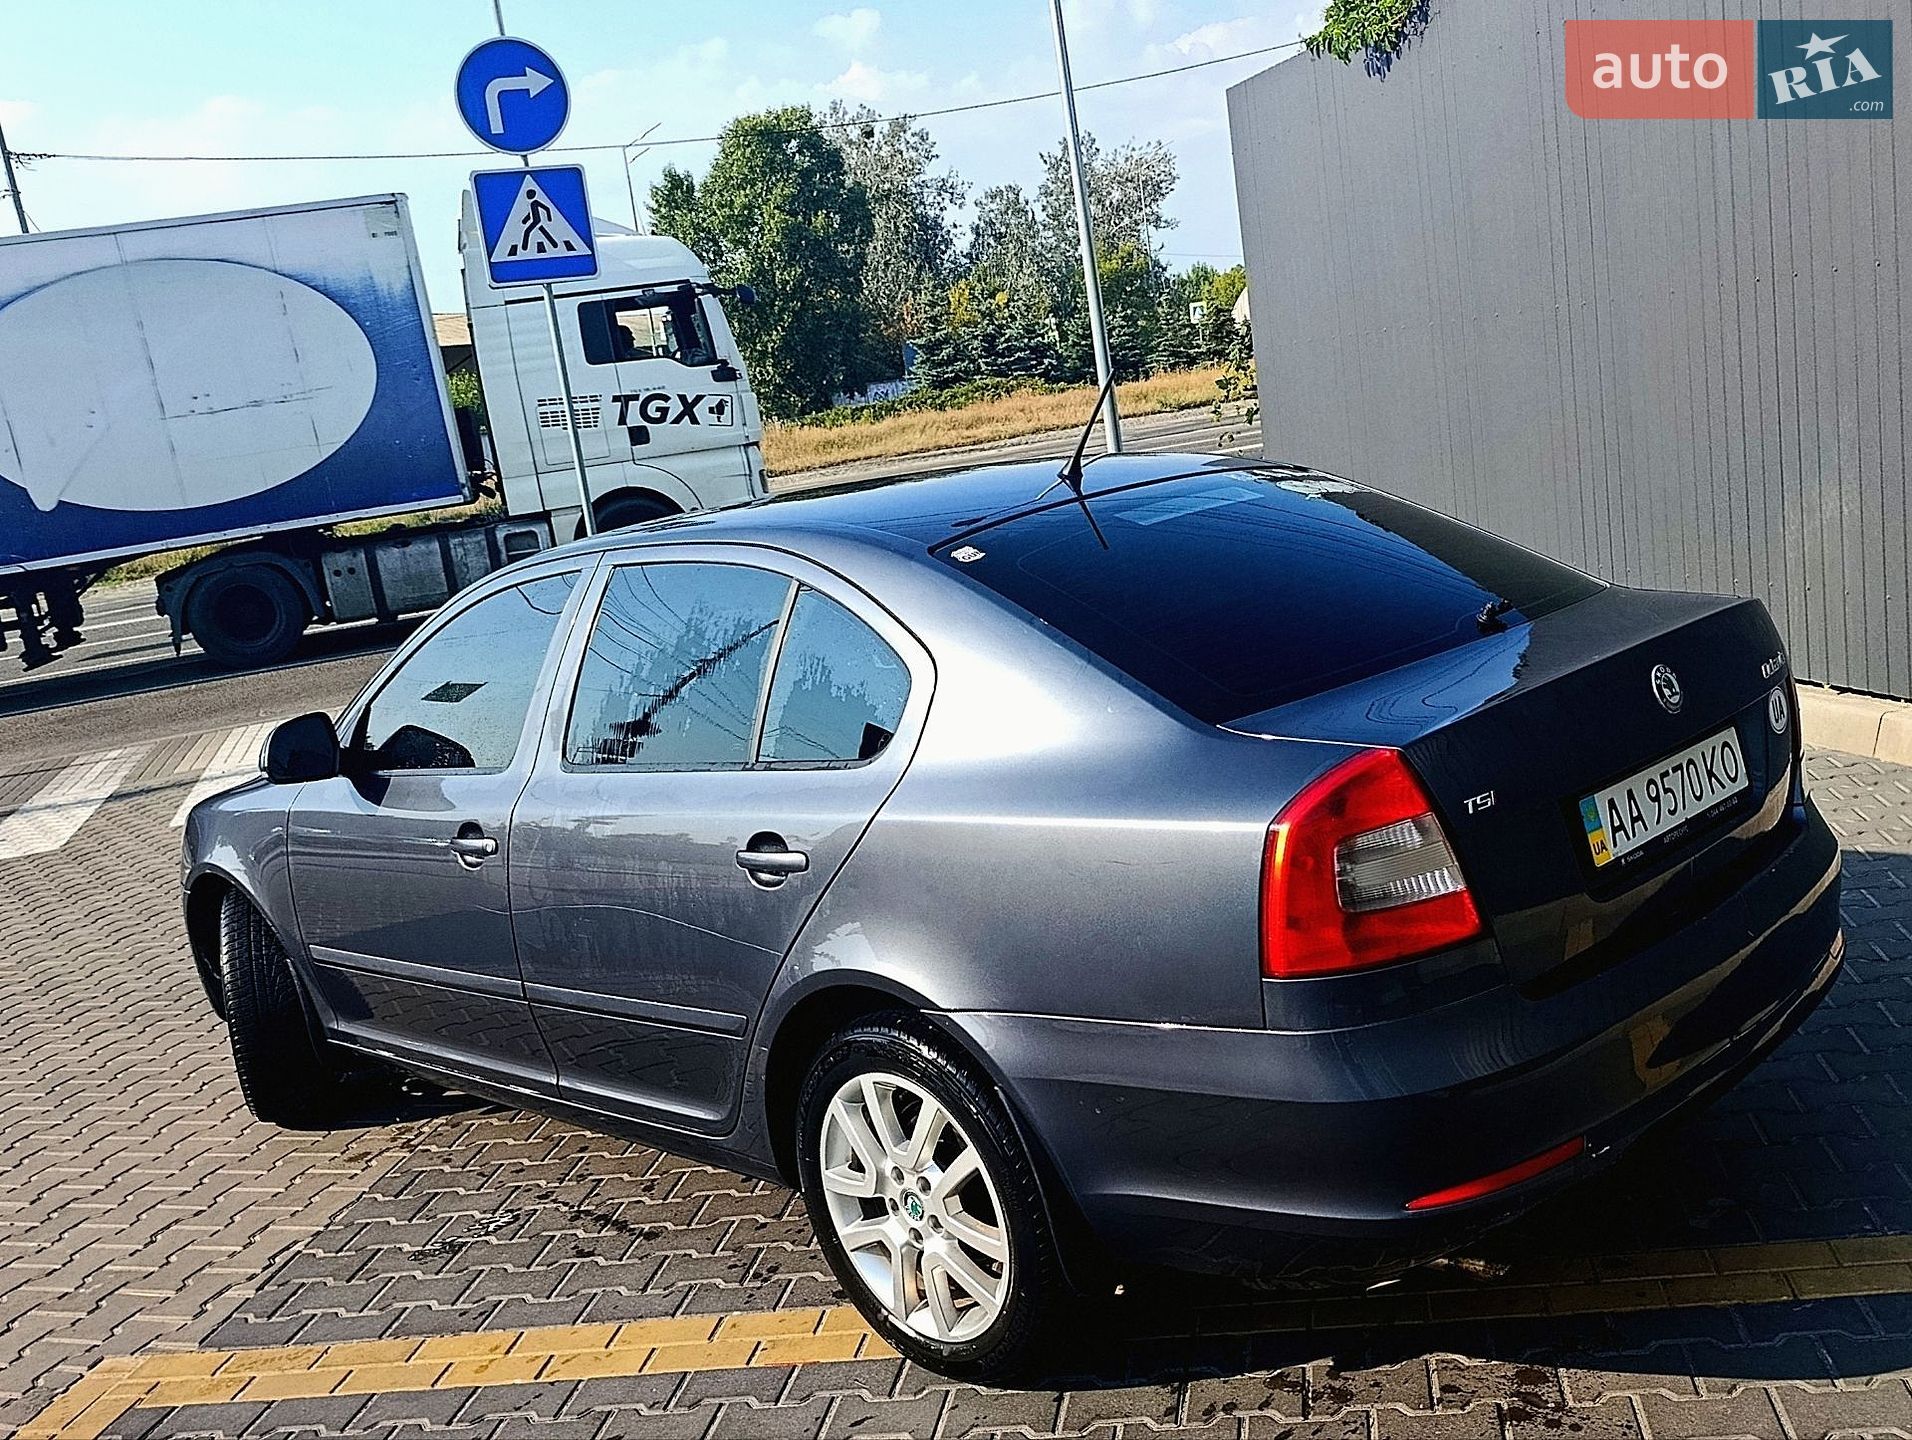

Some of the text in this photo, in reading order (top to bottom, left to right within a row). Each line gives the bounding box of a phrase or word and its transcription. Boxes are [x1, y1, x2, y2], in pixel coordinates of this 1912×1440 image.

[611, 392, 708, 426] TGX
[1770, 695, 1786, 724] UA
[1463, 790, 1495, 815] TSI
[1606, 740, 1740, 849] AA 9570 KO
[1592, 840, 1608, 856] UA
